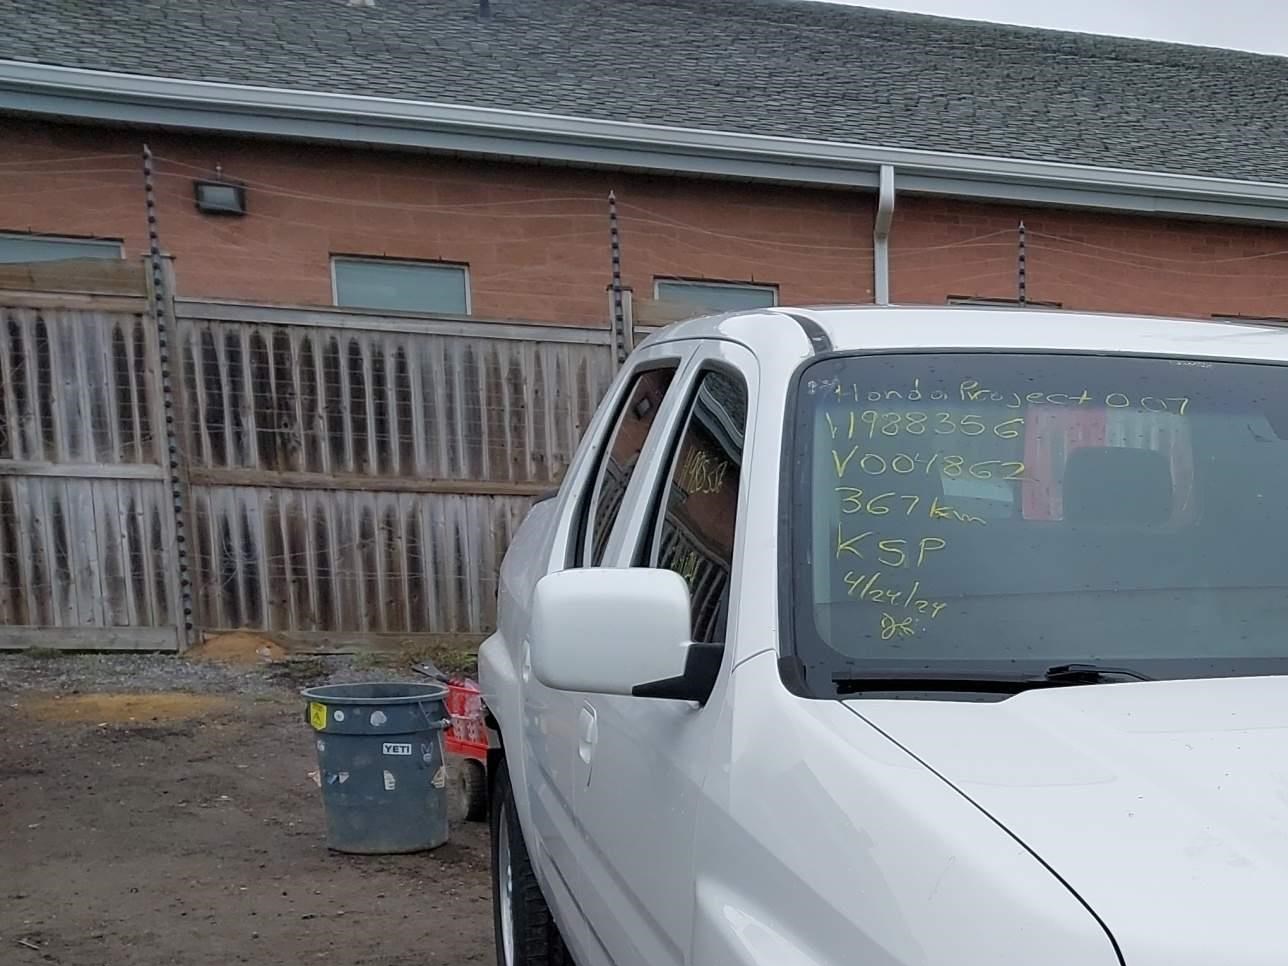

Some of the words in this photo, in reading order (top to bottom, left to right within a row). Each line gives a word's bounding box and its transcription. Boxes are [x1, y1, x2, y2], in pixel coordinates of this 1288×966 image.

[958, 379, 1093, 409] Project
[1104, 392, 1190, 416] 007
[825, 409, 1026, 439] 11988356
[834, 486, 920, 516] 367
[843, 571, 948, 618] 4/24/24
[384, 744, 410, 753] YETI
